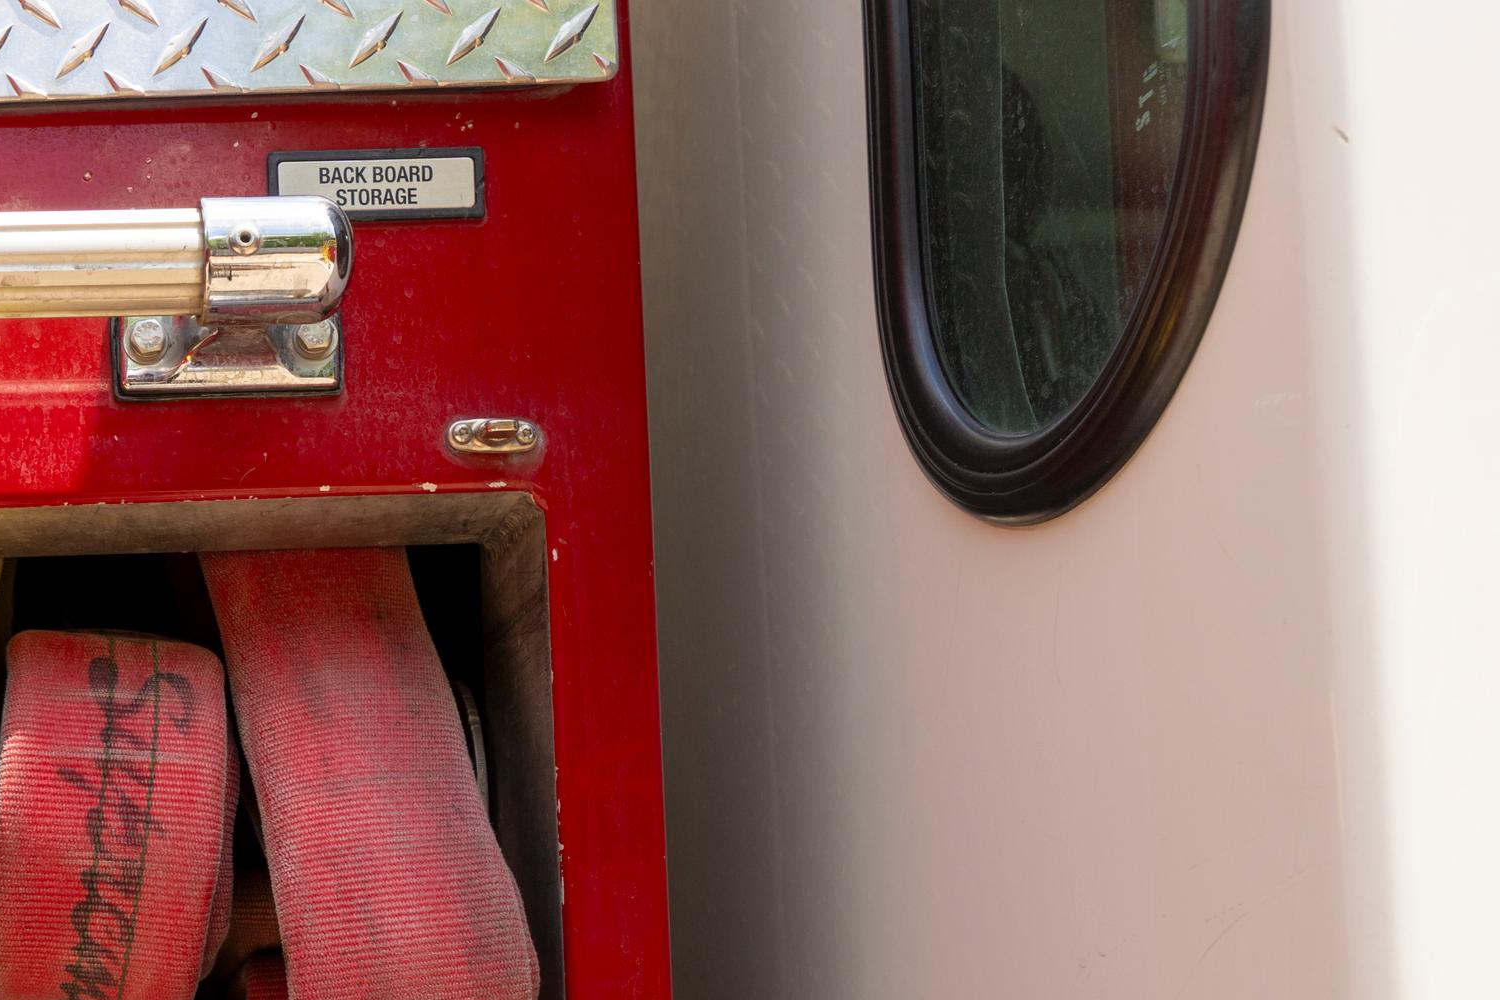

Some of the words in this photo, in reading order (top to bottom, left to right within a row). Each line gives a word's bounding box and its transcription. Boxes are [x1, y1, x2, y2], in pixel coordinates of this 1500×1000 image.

[318, 166, 367, 185] BACK
[372, 165, 433, 183] BOARD
[336, 187, 418, 206] STORAGE
